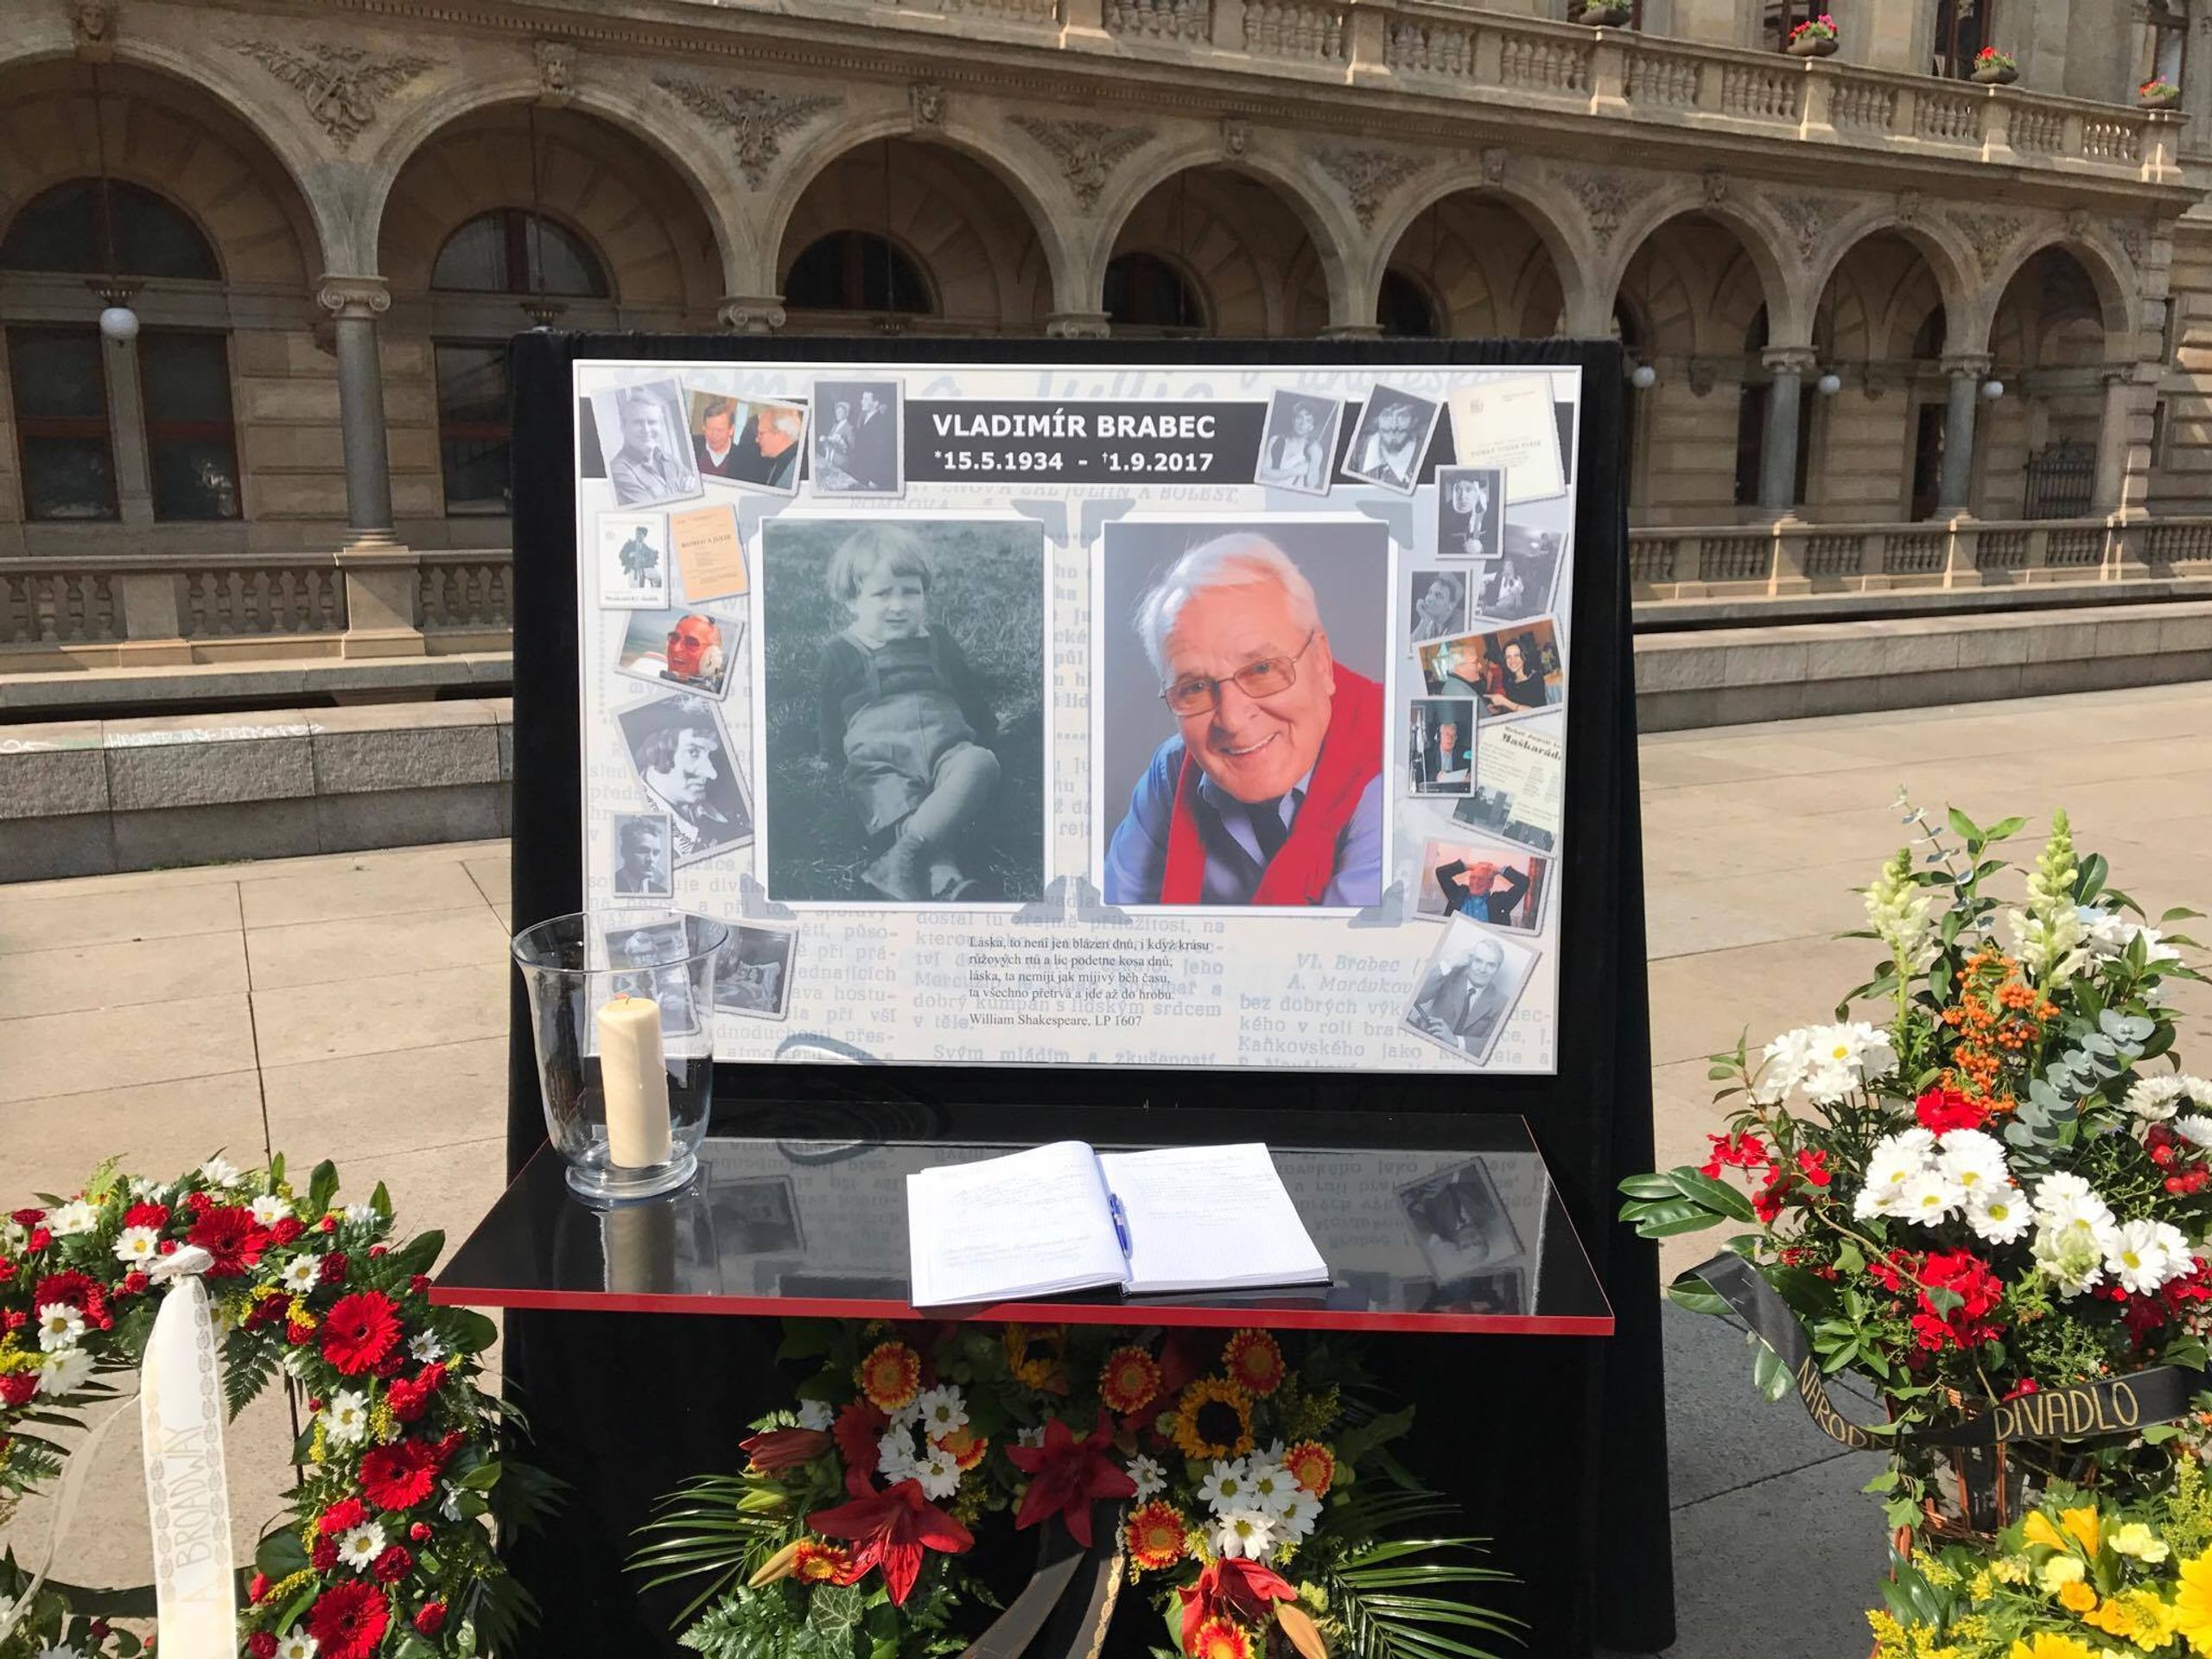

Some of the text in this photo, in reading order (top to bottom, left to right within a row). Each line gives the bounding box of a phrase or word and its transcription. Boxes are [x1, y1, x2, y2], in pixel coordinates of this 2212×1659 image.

[932, 408, 1216, 439] VLADIMÍR BRABEC
[1204, 919, 1225, 933] na
[969, 936, 1007, 950] Láska,
[1009, 938, 1021, 949] to
[1050, 938, 1069, 951] jen
[1147, 938, 1176, 953] když
[969, 953, 1021, 967] růžových
[1071, 955, 1116, 968] podetne
[1118, 955, 1145, 967] kosa
[1335, 953, 1401, 973] Brabec
[969, 969, 1001, 982] láska,
[1005, 971, 1015, 982] ta
[1057, 970, 1075, 983] jak
[969, 988, 979, 998] ta
[983, 987, 1028, 999] všechno
[1121, 988, 1135, 1000] do
[1153, 1001, 1222, 1017] srdcem
[1239, 993, 1271, 1010] bez
[1280, 995, 1357, 1017] dobrých
[969, 1013, 1014, 1026] William
[1095, 1015, 1111, 1027] LP
[1115, 1015, 1141, 1027] 1607
[1297, 1020, 1309, 1034] v
[1382, 1043, 1422, 1060] jako
[1993, 1381, 2139, 1441] DIVADLO
[163, 1425, 213, 1569] BROADWAY
